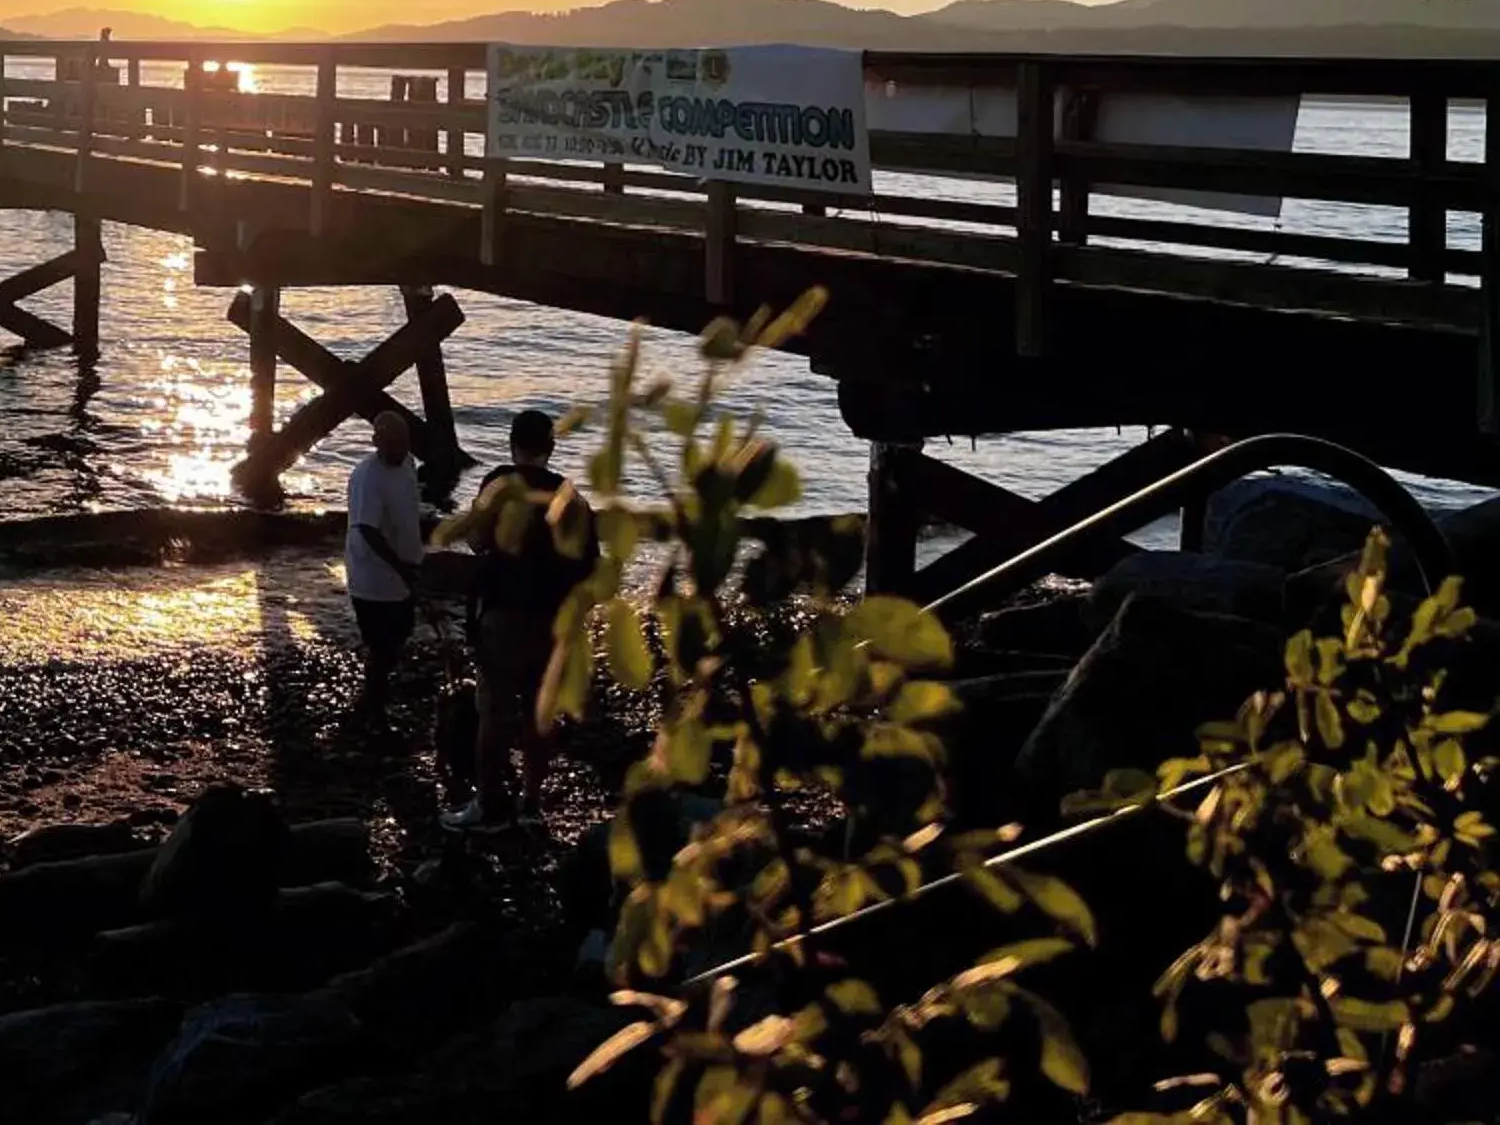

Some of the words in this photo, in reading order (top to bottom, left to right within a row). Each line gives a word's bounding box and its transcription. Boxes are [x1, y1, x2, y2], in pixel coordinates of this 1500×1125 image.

[659, 95, 855, 150] COMPETITION
[683, 143, 707, 168] BY
[713, 148, 755, 173] JIM
[763, 152, 858, 184] TAYLOR
